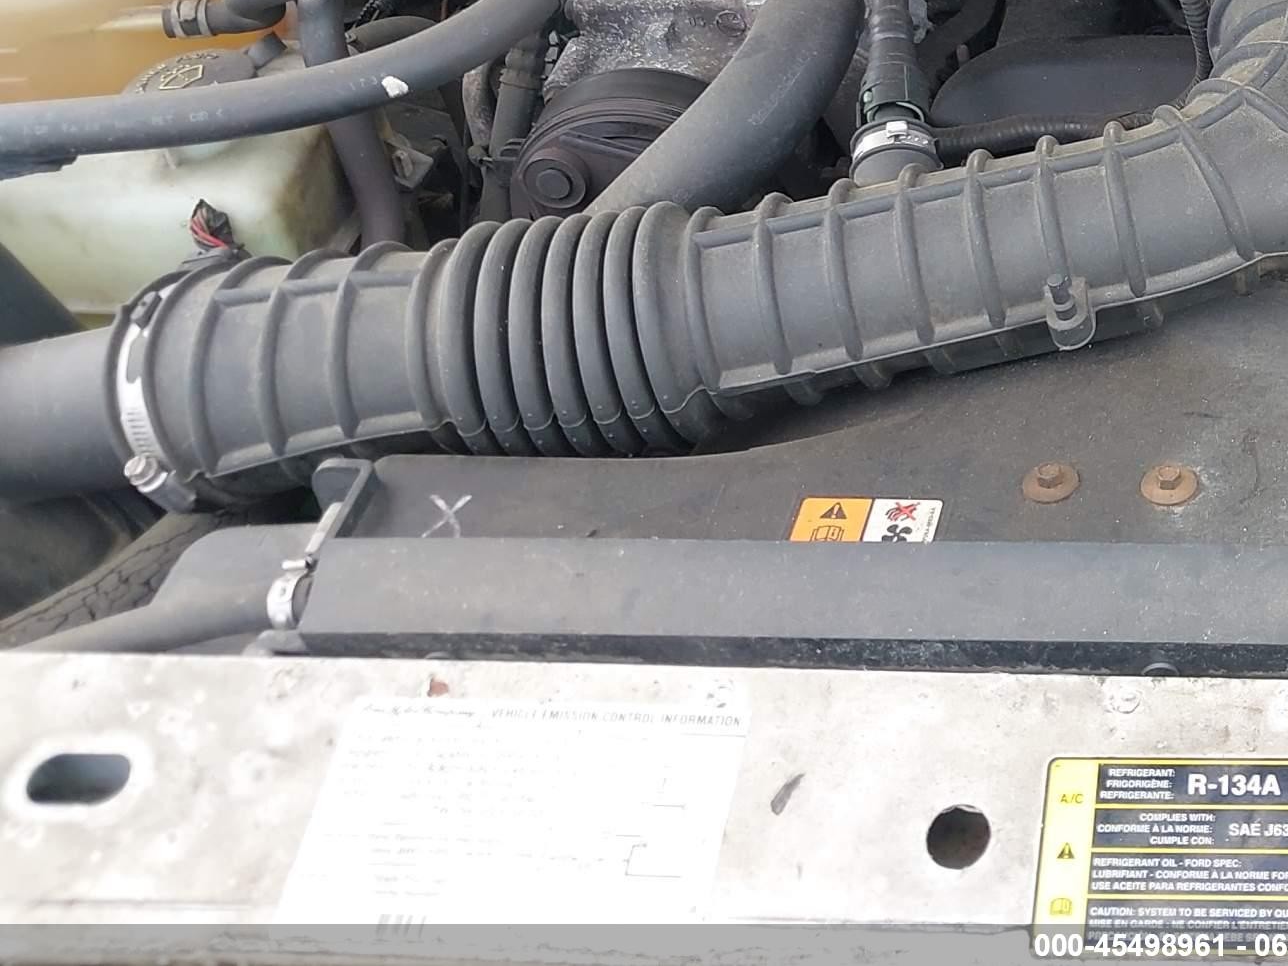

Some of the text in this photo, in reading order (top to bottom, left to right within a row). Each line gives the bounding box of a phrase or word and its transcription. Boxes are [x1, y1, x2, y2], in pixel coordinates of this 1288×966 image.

[658, 712, 743, 728] INFORMATION
[1108, 769, 1175, 777] REFRIGERANT:
[1188, 774, 1281, 796] R-134A
[1100, 791, 1175, 800] REFRIGERANTE:
[1140, 814, 1215, 822] COMPLIES WITH:
[1229, 824, 1261, 836] SAE
[1150, 836, 1215, 845] CUMPLE CON:
[1093, 858, 1242, 868] REFRIGERANT OIL FORD SPEC:
[1092, 870, 1148, 878] LUBRIFIANT
[1155, 871, 1210, 879] CONFORME
[1235, 872, 1270, 880] NORME
[1091, 882, 1111, 890] USE
[1113, 882, 1147, 890] ACEITE
[1176, 883, 1256, 891] REFRIGERANTES
[1090, 907, 1135, 916] CAUTION:
[1139, 907, 1177, 916] SYSTEM
[1180, 908, 1192, 917] TO
[1194, 908, 1208, 917] BE
[1209, 908, 1258, 917] SERVICED
[1260, 909, 1273, 917] BY
